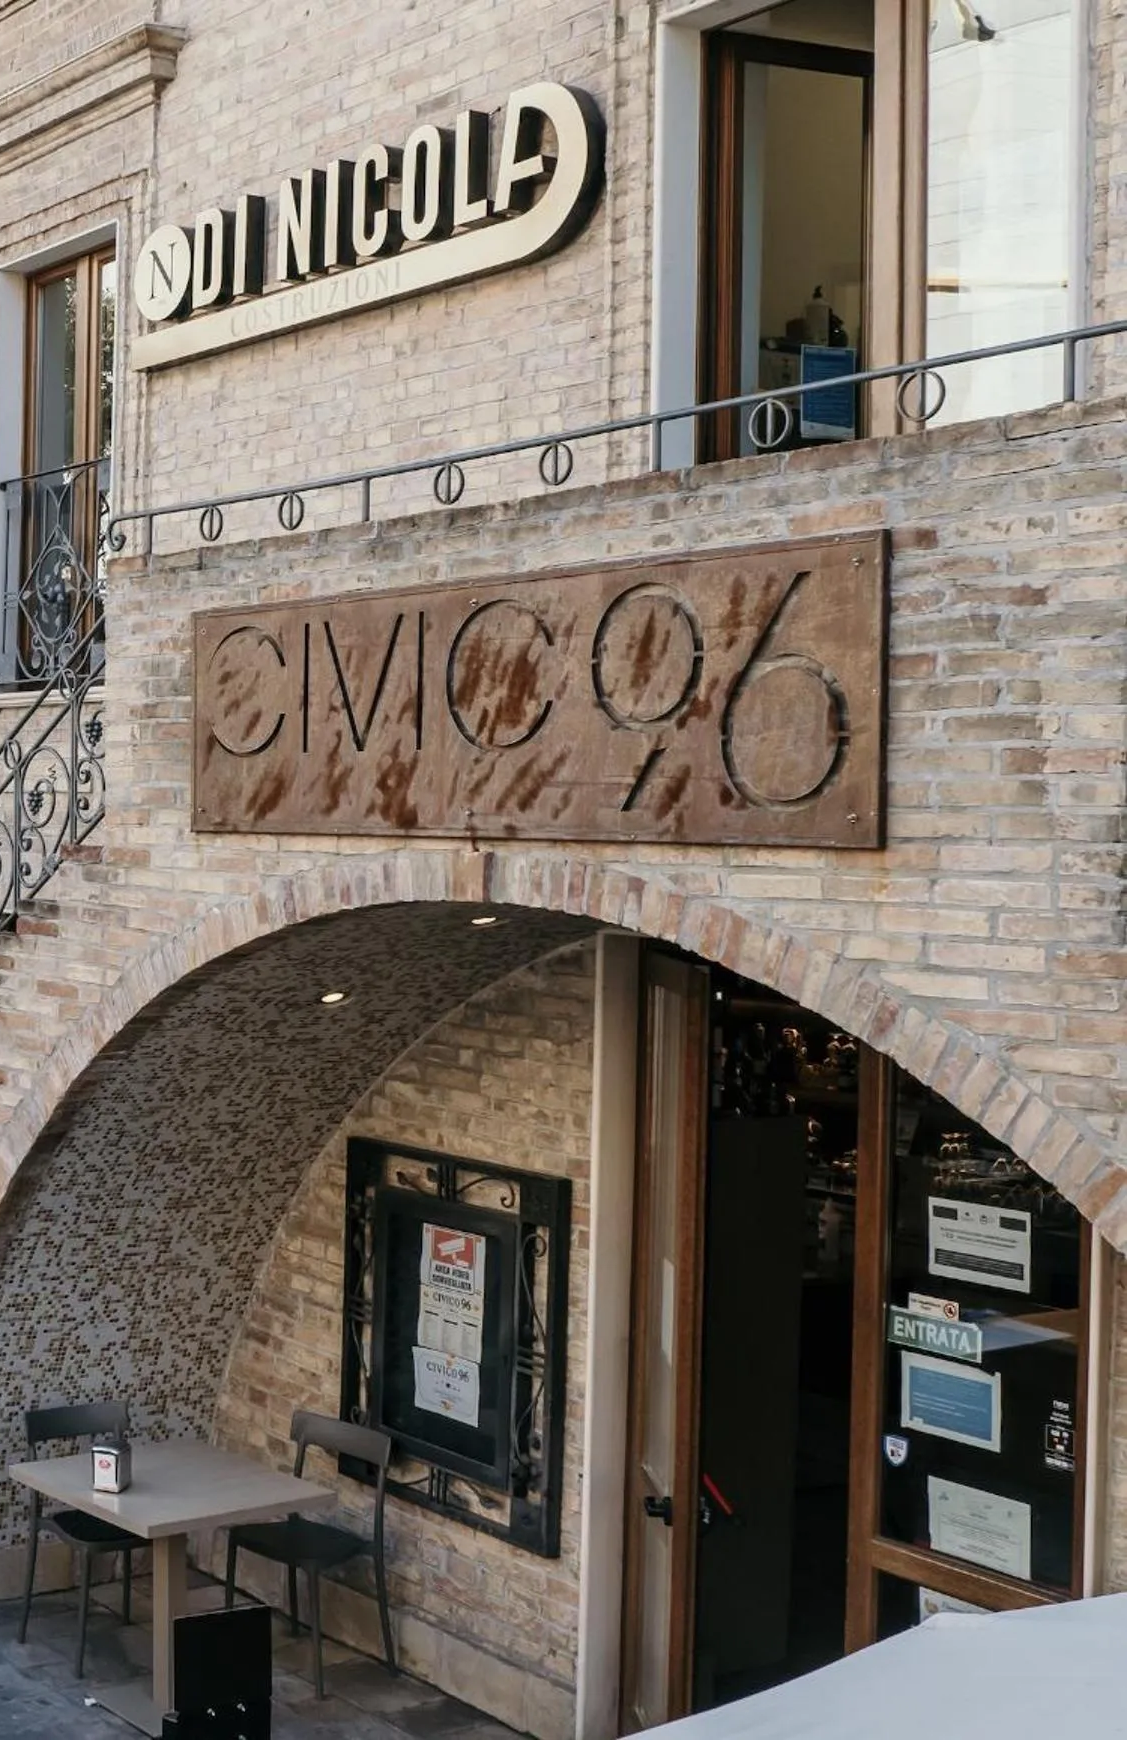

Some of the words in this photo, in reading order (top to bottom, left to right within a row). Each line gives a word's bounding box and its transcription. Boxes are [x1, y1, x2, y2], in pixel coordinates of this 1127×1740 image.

[149, 242, 177, 300] N
[192, 194, 265, 309] DI
[277, 81, 607, 283] NICOLA
[230, 261, 401, 338] COSTRUZIONI
[893, 1315, 972, 1354] ENTRATA
